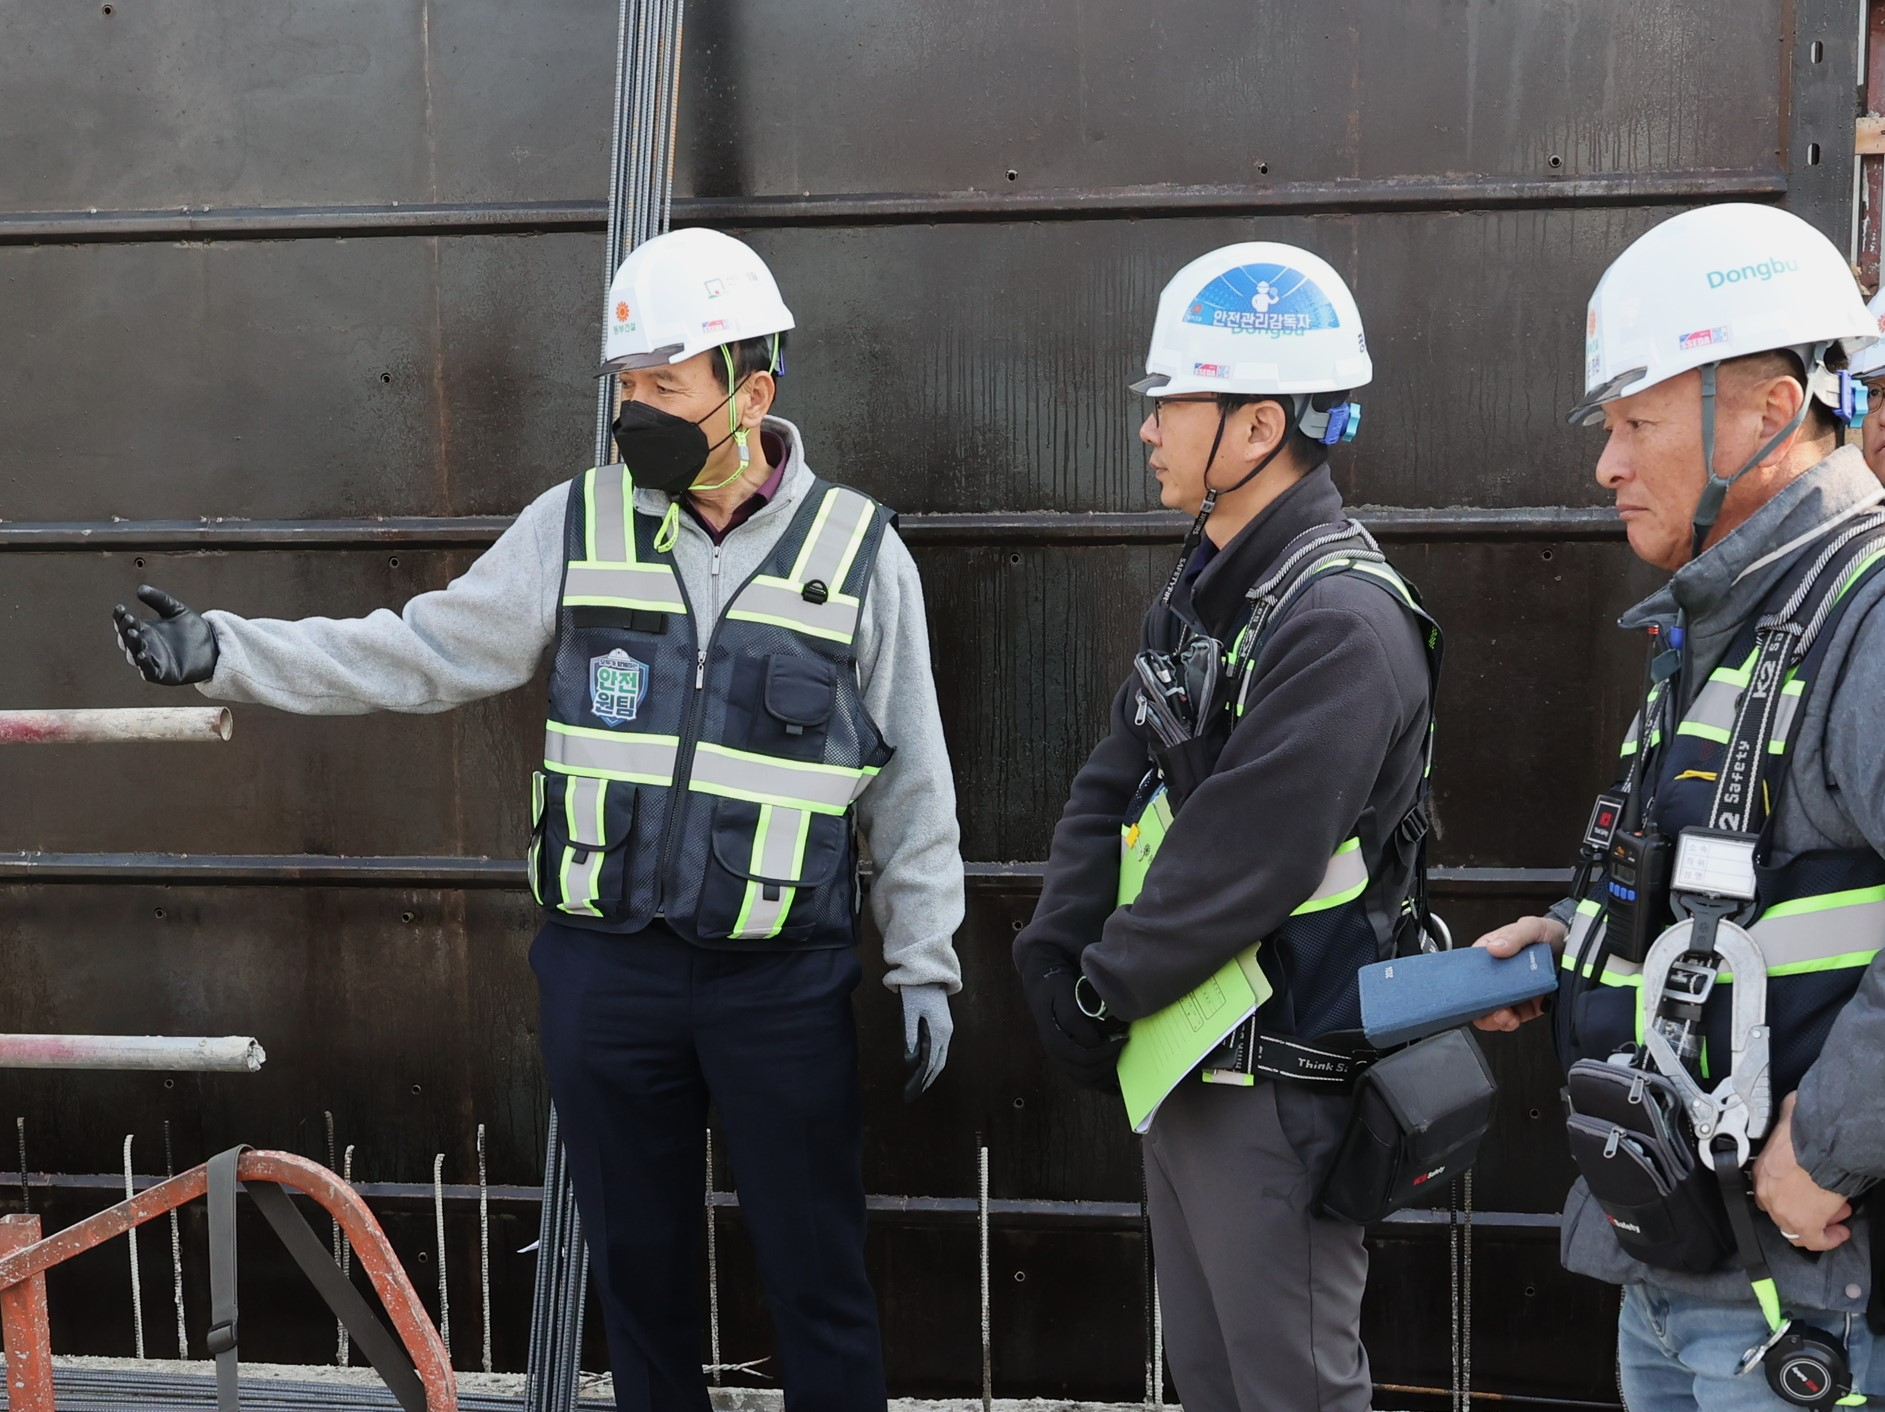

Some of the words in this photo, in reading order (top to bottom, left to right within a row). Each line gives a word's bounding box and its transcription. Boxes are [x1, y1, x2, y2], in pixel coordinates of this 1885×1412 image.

[1706, 257, 1799, 289] Dongbu
[1213, 310, 1311, 330] 안전관리감독자
[599, 668, 638, 694] 안전
[1752, 660, 1777, 698] K2
[595, 692, 636, 717] 원팀
[1724, 740, 1750, 803] Safety
[1718, 812, 1740, 831] 2
[1298, 1057, 1334, 1073] Think
